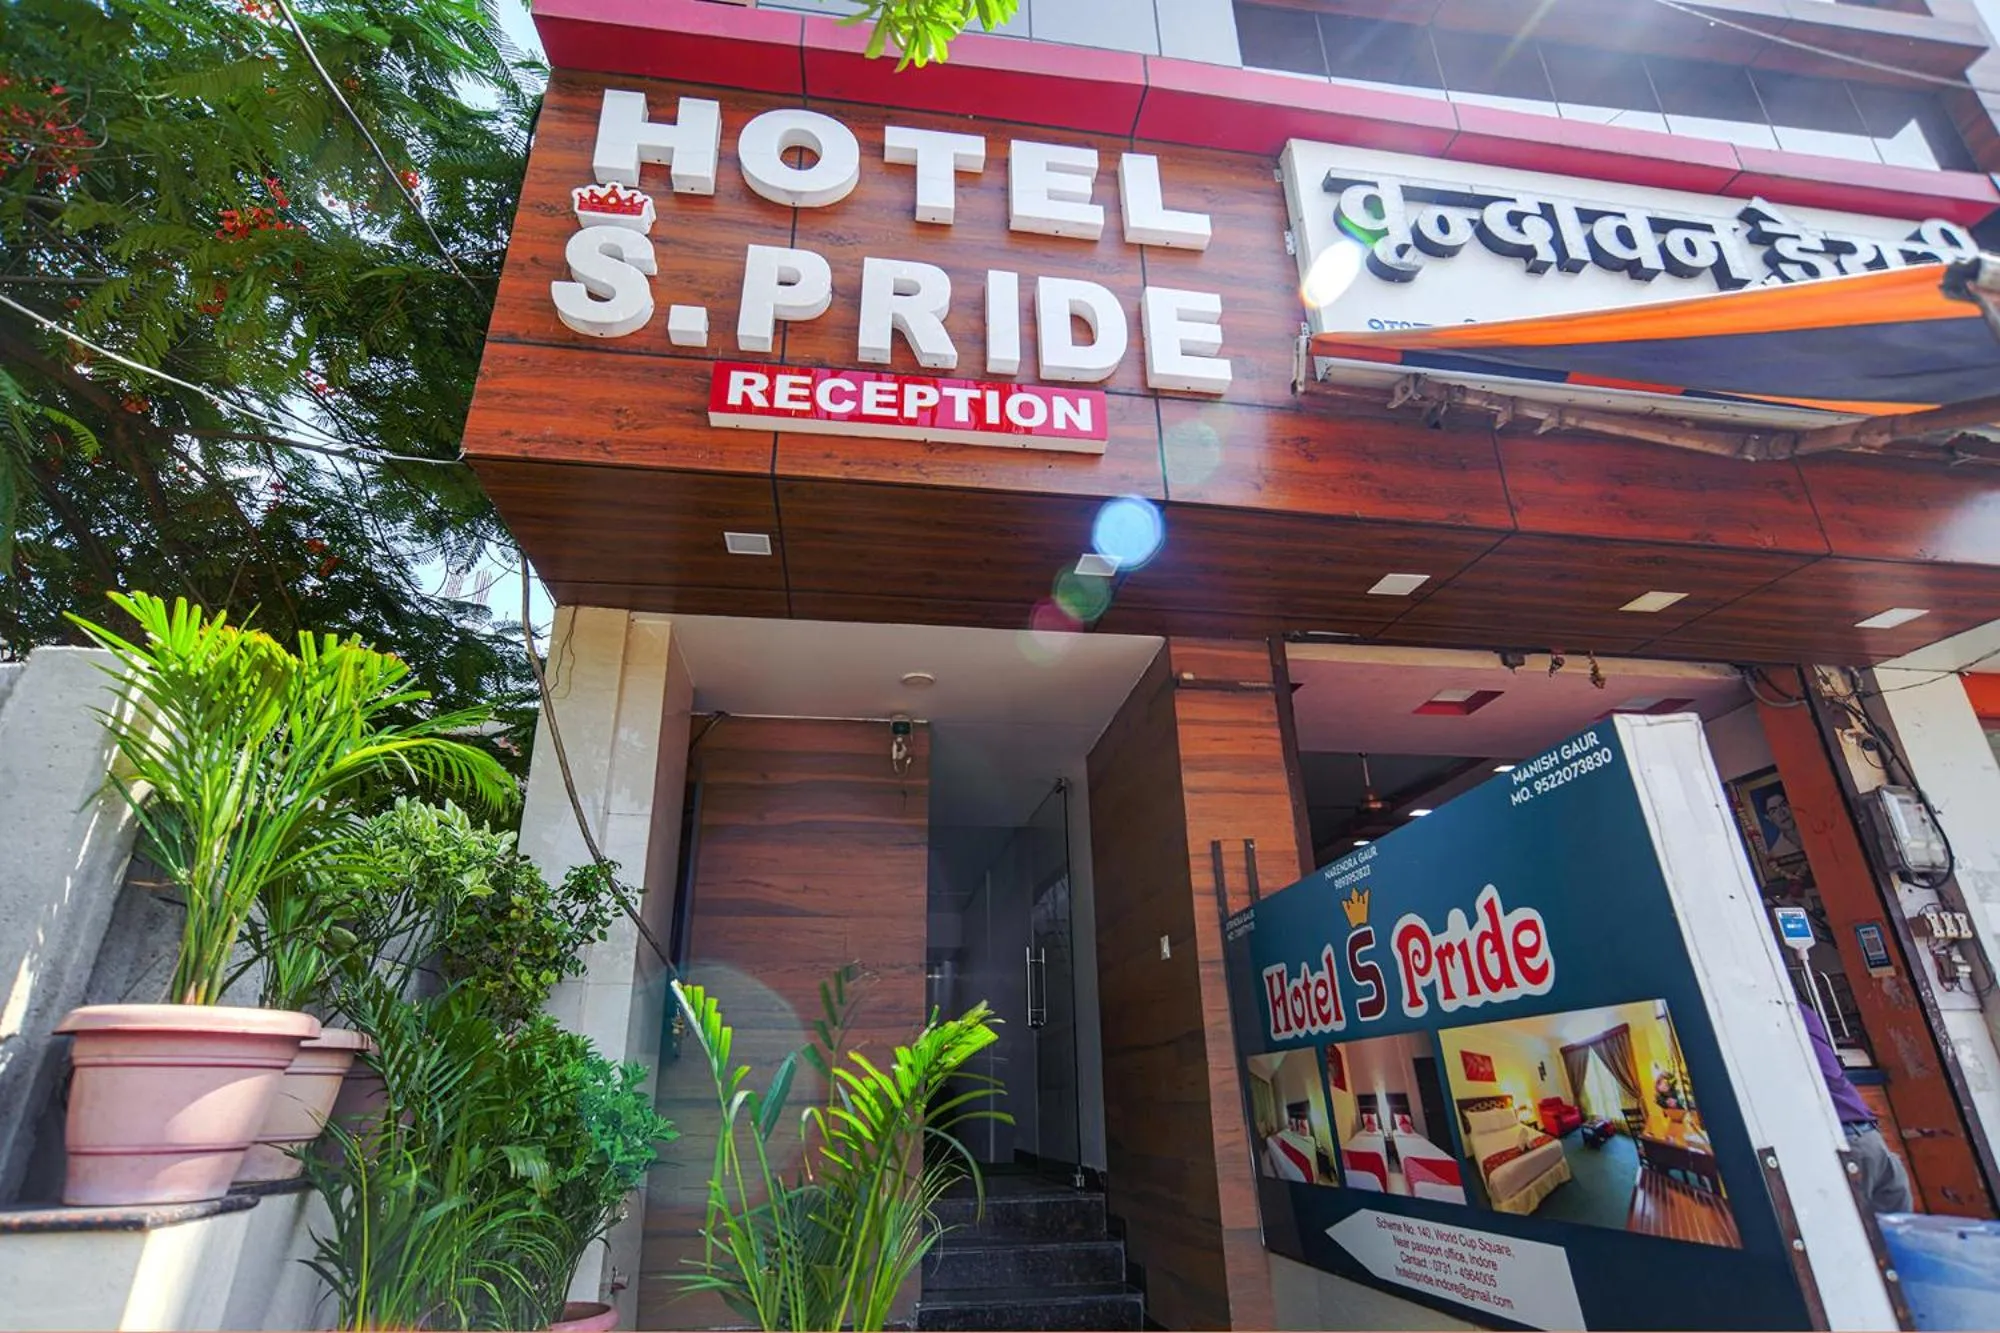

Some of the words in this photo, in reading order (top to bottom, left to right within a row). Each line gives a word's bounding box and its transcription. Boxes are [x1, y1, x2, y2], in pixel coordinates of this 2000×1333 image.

[592, 89, 1212, 251] HOTEL
[726, 370, 1094, 432] RECEPTION
[1510, 786, 1534, 807] MO.
[1533, 747, 1613, 795] 9522073830
[1511, 750, 1560, 785] MANISH
[1561, 731, 1600, 760] GAUR
[1263, 946, 1345, 1039] Hotel
[1347, 927, 1386, 1022] S
[1393, 889, 1553, 1015] Pride
[1459, 1234, 1477, 1250] Cup
